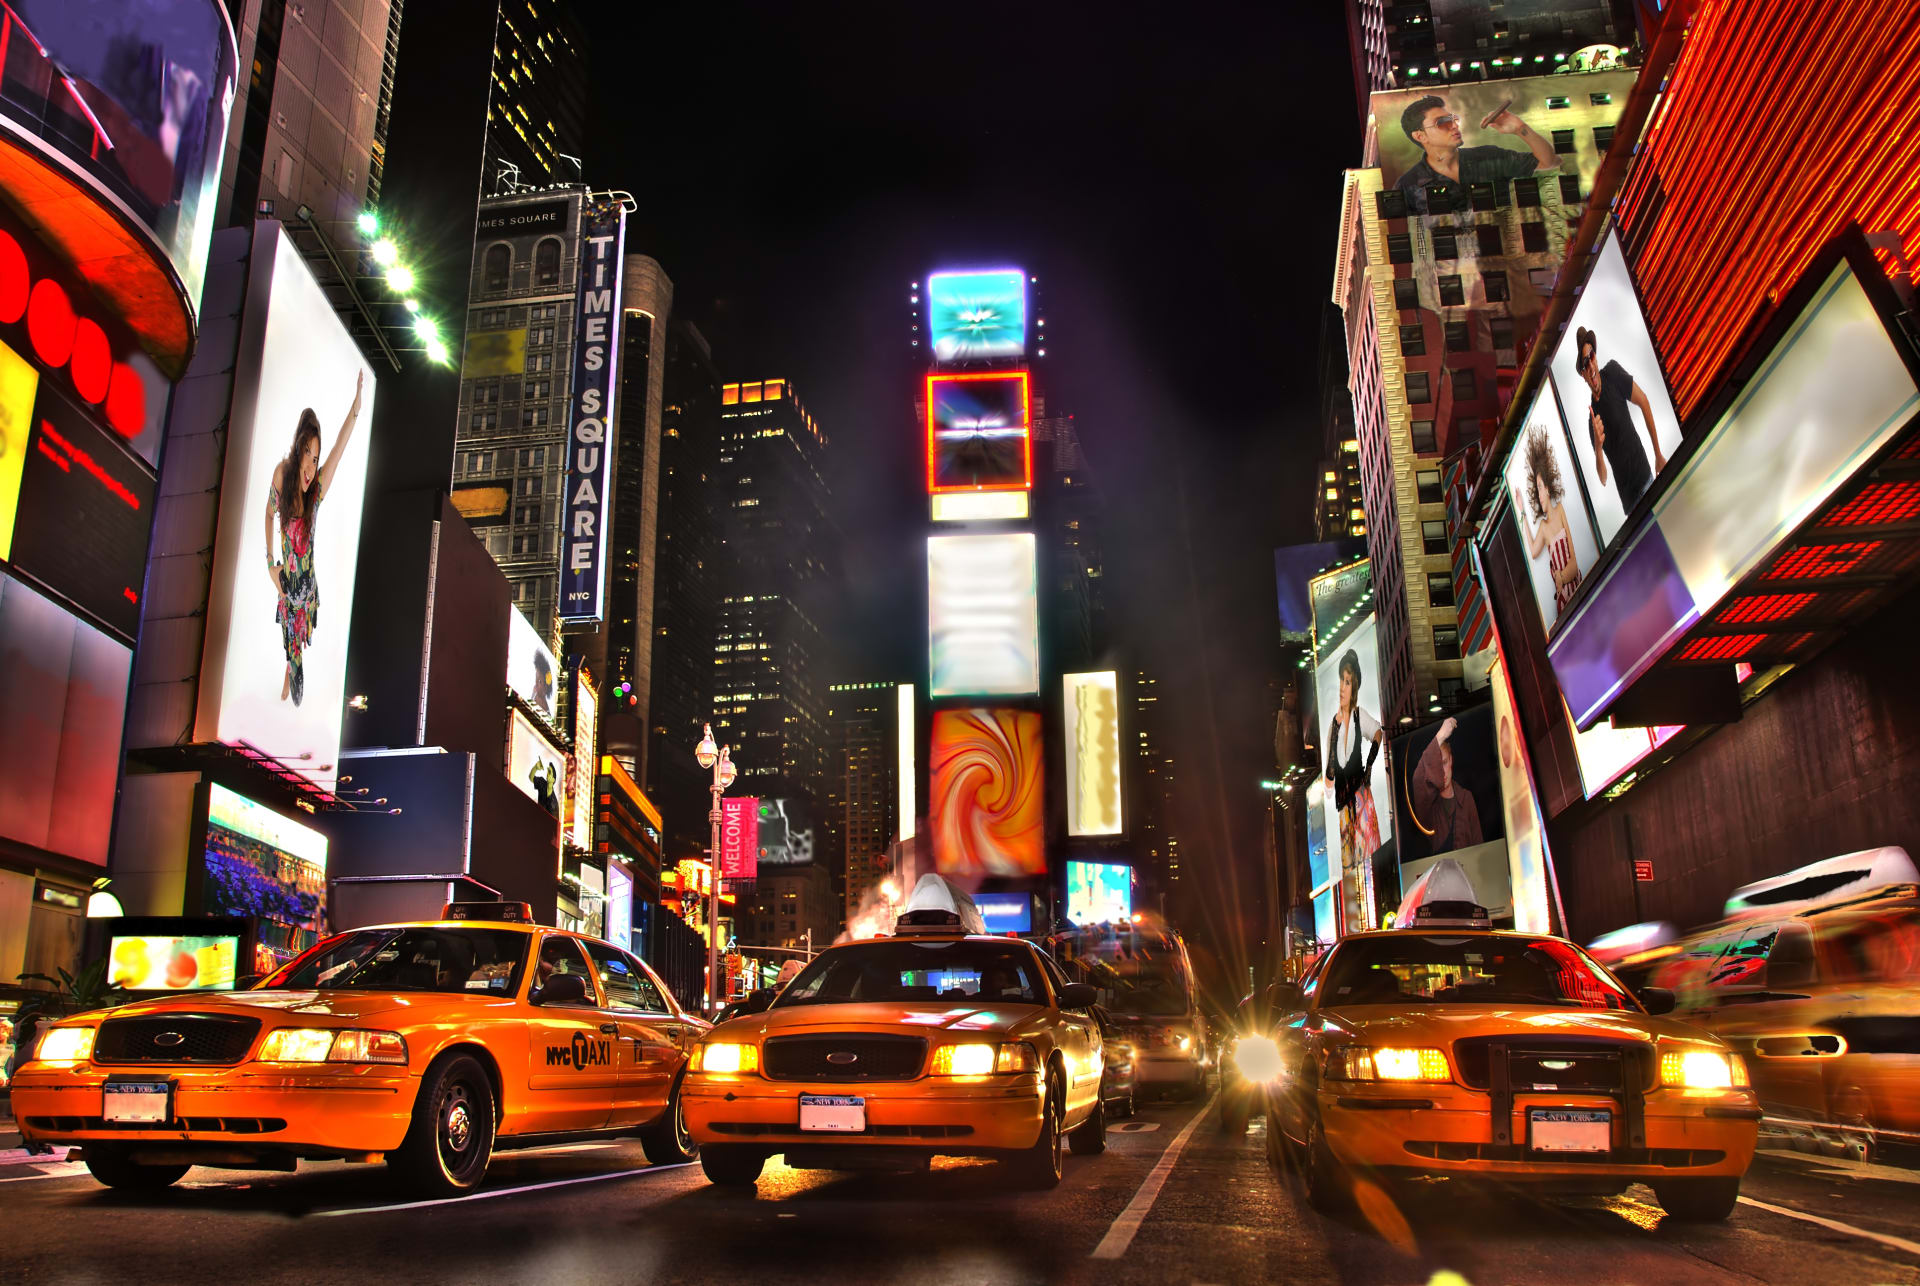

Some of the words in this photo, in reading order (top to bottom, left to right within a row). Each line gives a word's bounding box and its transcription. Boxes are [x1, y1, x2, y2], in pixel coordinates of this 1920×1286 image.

[478, 218, 505, 229] IMES
[510, 212, 557, 226] SQUARE
[584, 236, 614, 371] TIMES
[570, 388, 604, 569] SQUARE
[568, 591, 590, 601] NYC
[1316, 580, 1333, 596] The
[725, 803, 741, 875] WELCOME
[546, 1046, 571, 1066] NYC
[573, 1037, 611, 1067] TAXI
[120, 1085, 136, 1093] NEW
[816, 1098, 831, 1106] NEW
[833, 1098, 849, 1107] YORK
[1551, 1113, 1567, 1121] NEW
[1570, 1114, 1591, 1122] YORK
